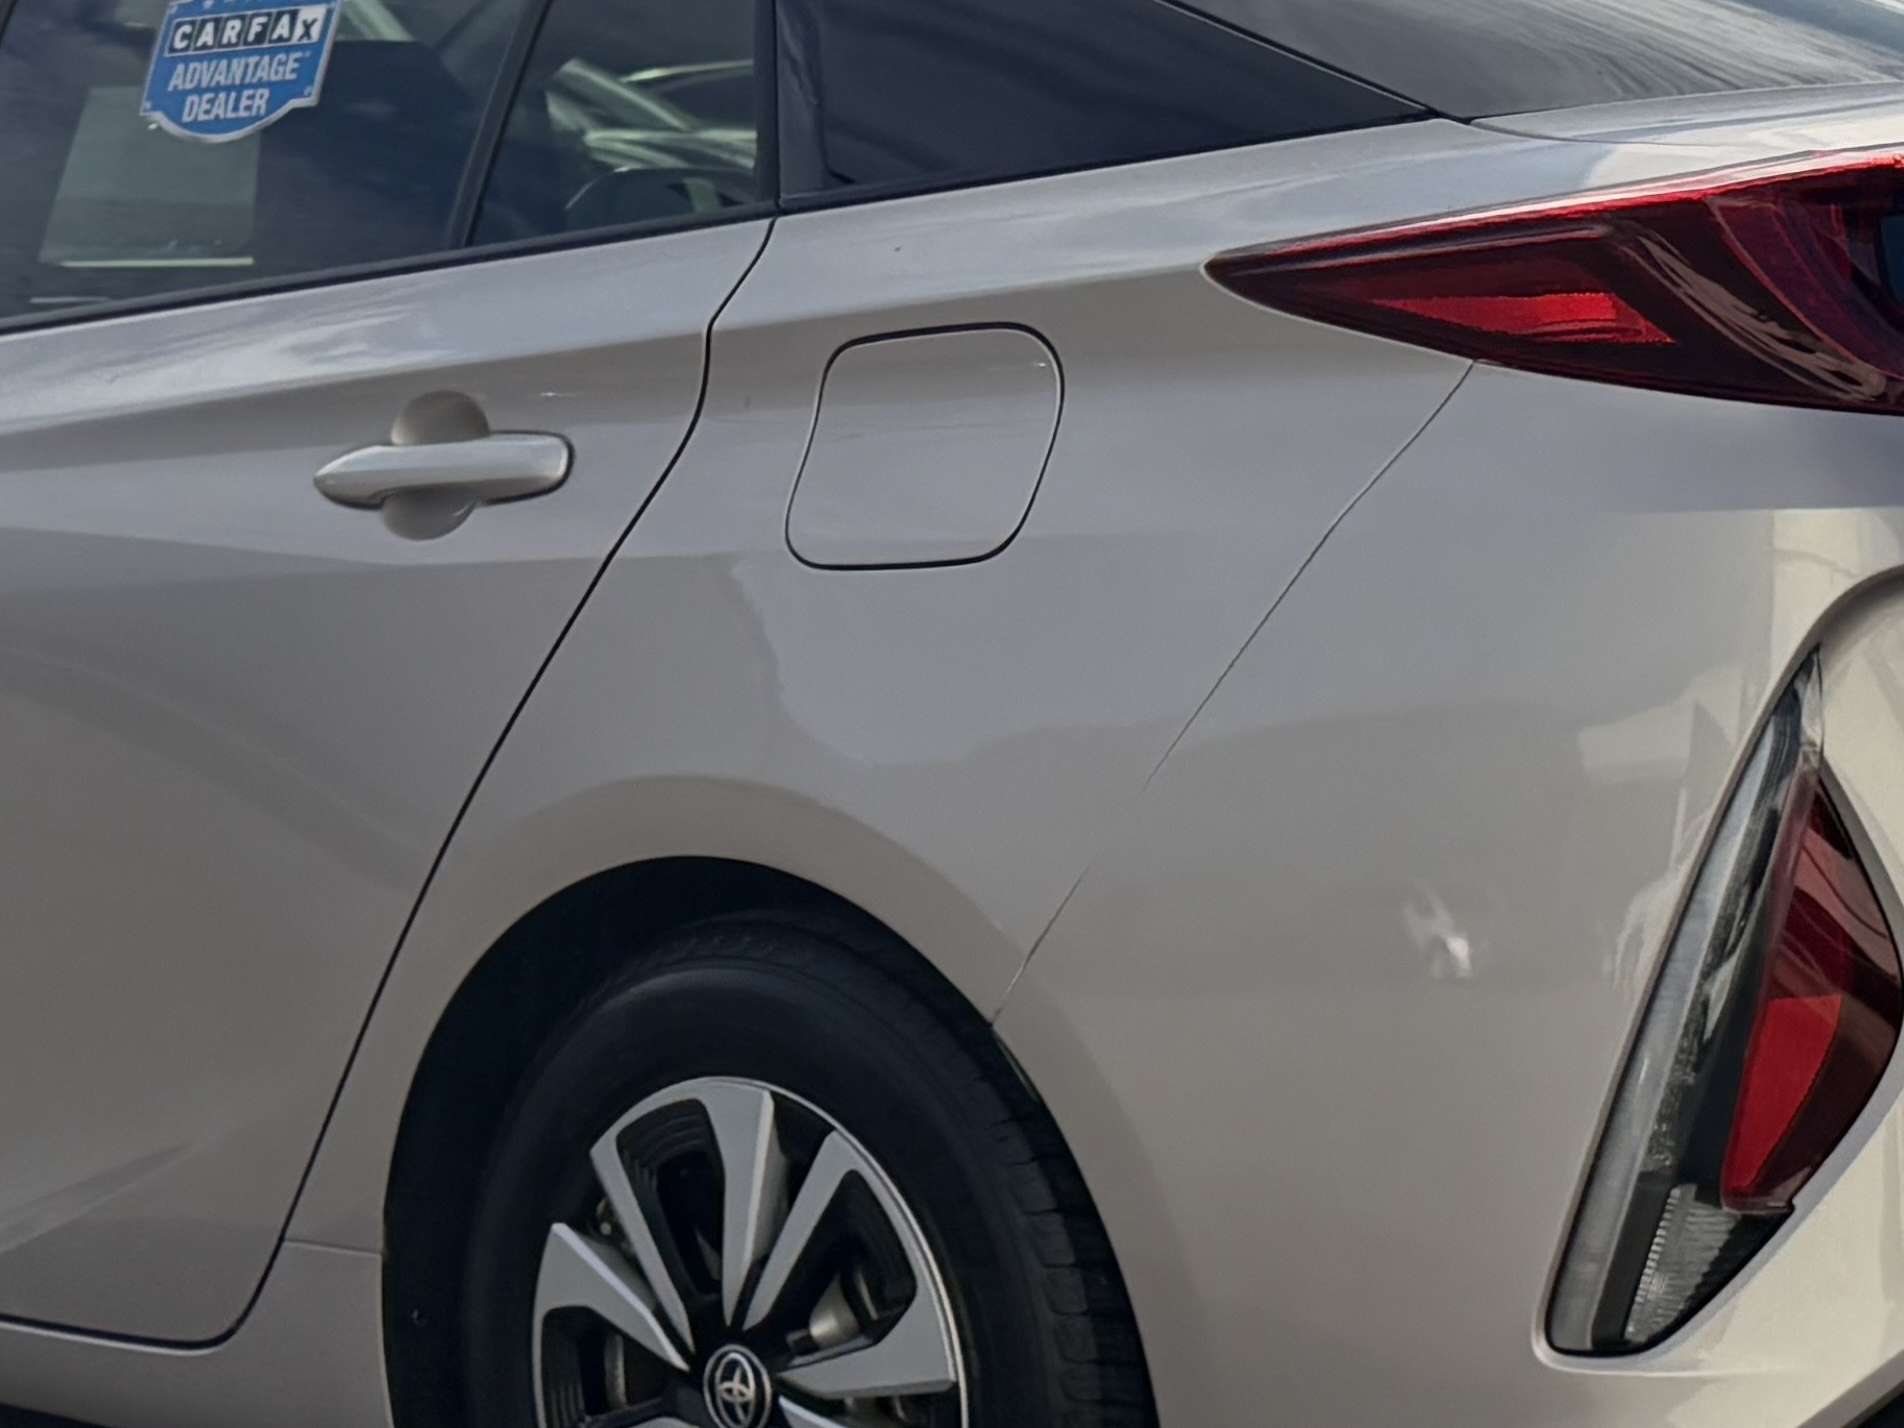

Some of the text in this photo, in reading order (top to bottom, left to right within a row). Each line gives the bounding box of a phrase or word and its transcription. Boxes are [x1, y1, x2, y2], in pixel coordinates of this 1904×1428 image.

[171, 9, 319, 51] CARFAX
[168, 52, 302, 91] ADVANTAGE
[182, 88, 271, 122] DEALER
